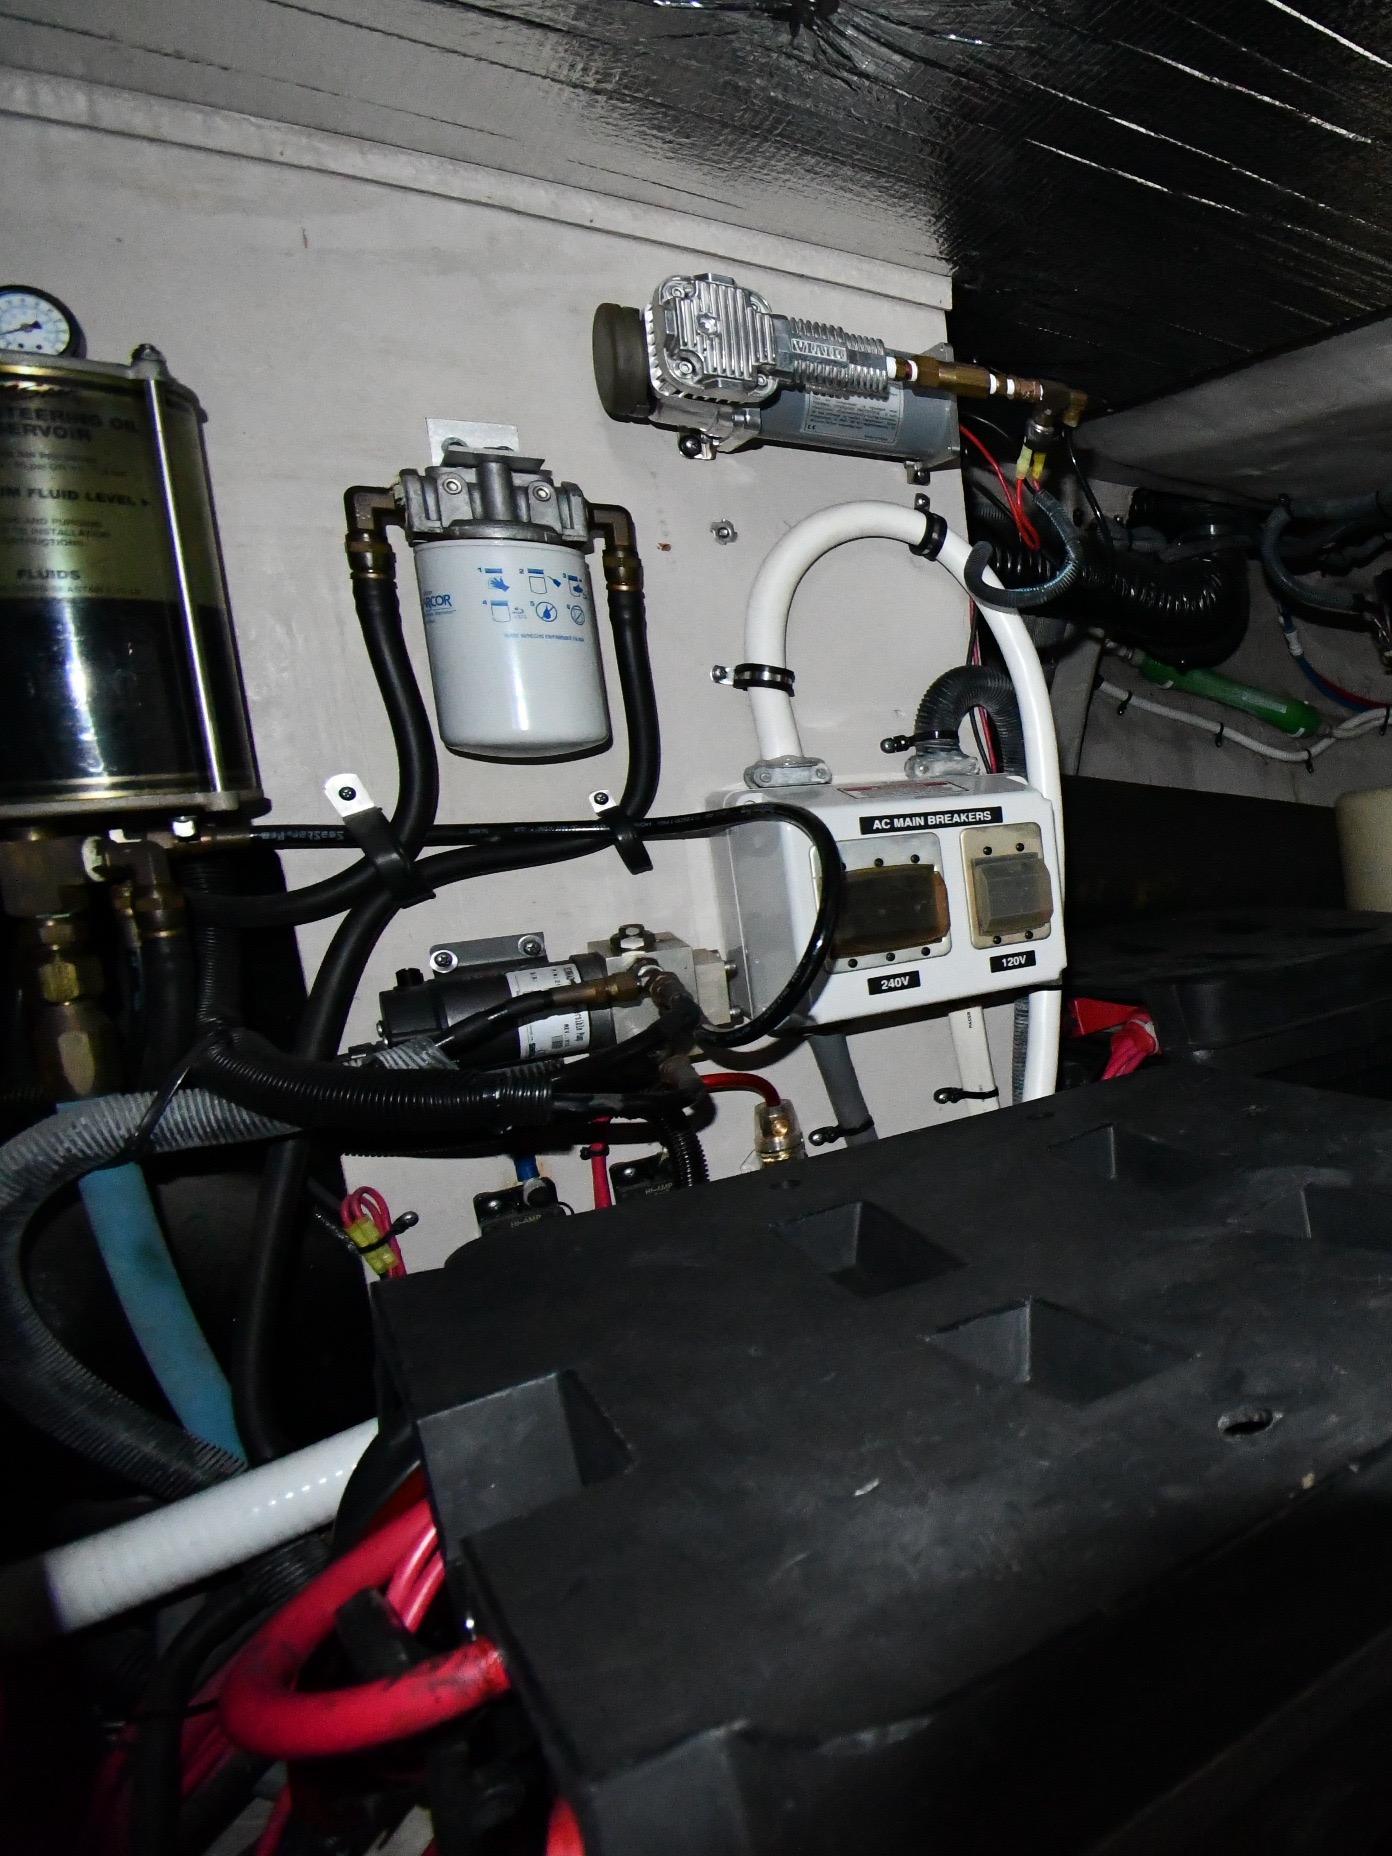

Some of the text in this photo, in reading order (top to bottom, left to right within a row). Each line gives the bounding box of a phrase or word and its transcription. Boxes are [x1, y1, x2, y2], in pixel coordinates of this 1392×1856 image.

[0, 407, 103, 426] TEERING
[28, 487, 79, 500] FLUID
[85, 491, 137, 506] LEVEL
[17, 568, 81, 581] FLUIDS
[872, 811, 992, 830] AC MAIN BREAKERS
[1001, 955, 1027, 968] 120V
[880, 976, 910, 990] 240V
